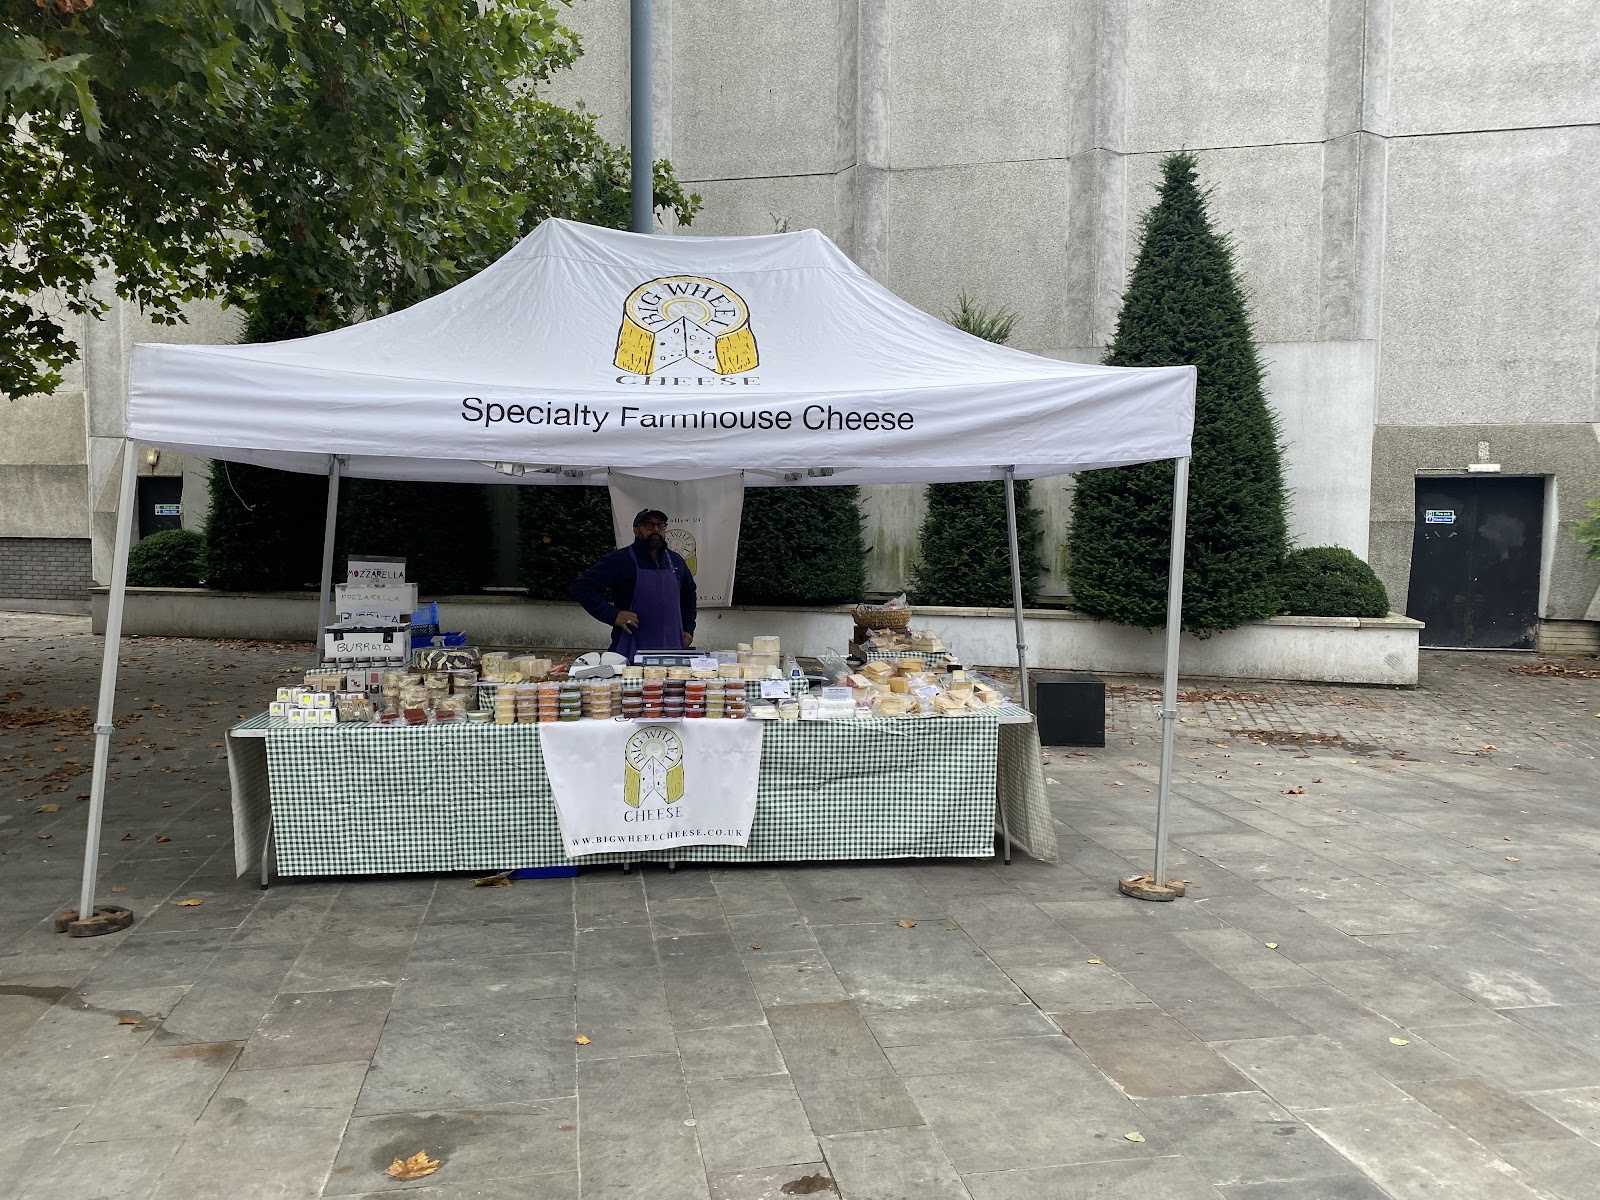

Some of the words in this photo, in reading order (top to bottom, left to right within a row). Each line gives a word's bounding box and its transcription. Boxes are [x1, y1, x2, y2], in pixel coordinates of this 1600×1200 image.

[638, 290, 669, 328] BIG
[664, 281, 736, 328] WHEEL
[615, 375, 761, 386] CHEESE
[461, 397, 609, 433] Specialty
[620, 406, 793, 430] Farmhouse
[802, 404, 915, 431] Cheese
[348, 570, 405, 580] MOZZARELLA
[336, 642, 392, 653] BURRATA
[631, 737, 645, 764] BIG
[644, 728, 678, 763] WHEEL
[623, 805, 684, 823] CHEESE
